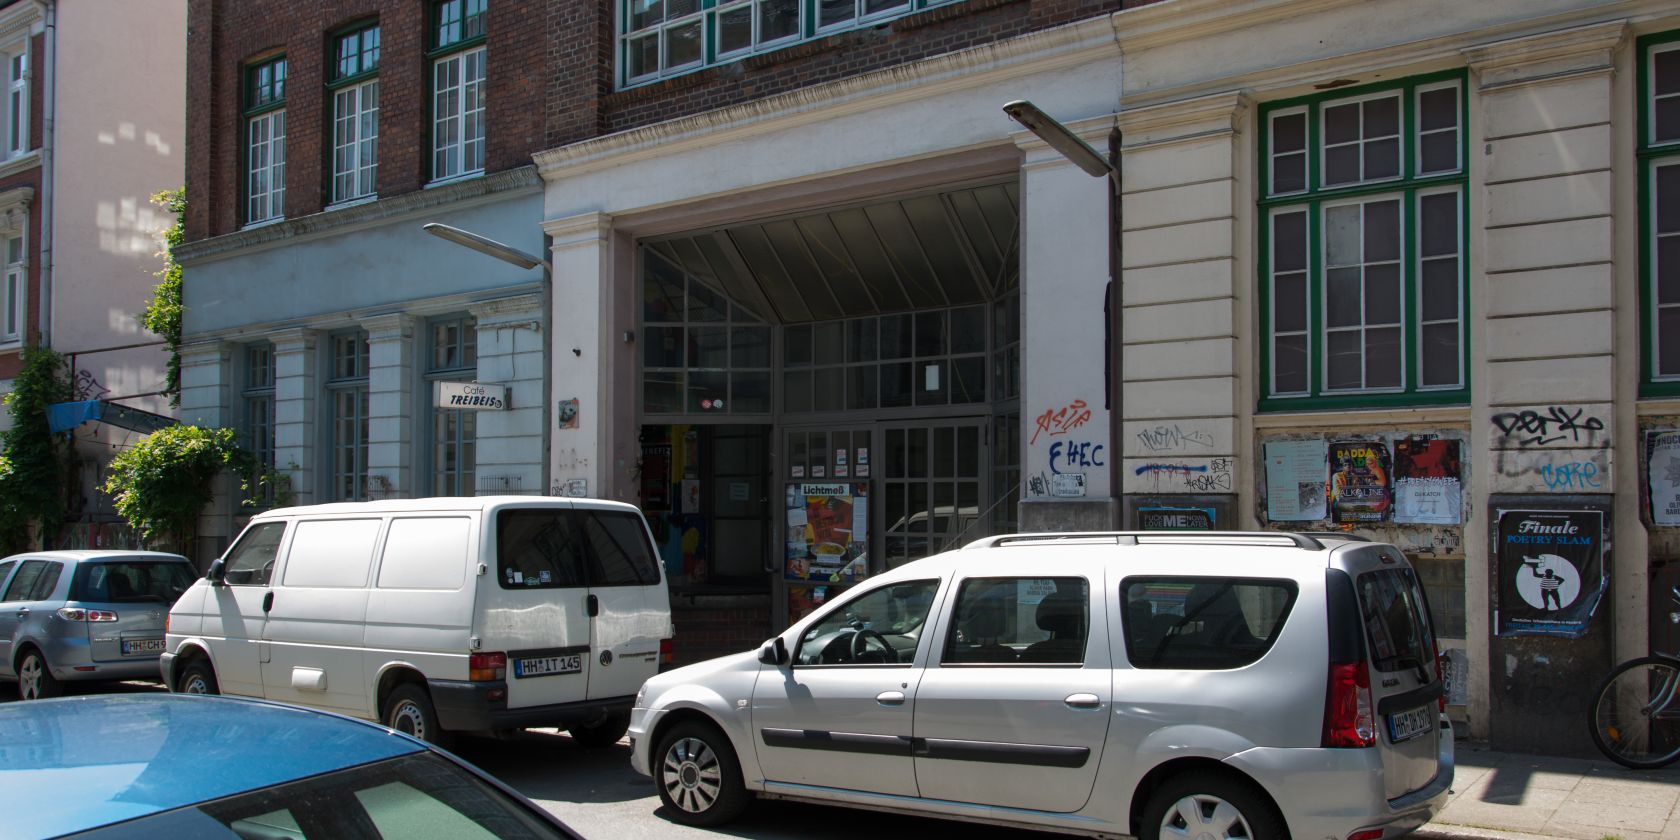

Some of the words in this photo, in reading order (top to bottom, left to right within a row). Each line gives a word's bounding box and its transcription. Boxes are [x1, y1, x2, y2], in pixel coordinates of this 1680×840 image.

[463, 385, 485, 395] Café
[450, 395, 496, 406] TREIBEIS
[803, 484, 844, 495] Lichtmeß
[1163, 515, 1186, 527] ME
[1518, 519, 1579, 535] Finale
[1507, 534, 1553, 545] POETRY
[1556, 535, 1592, 545] SLAM
[129, 642, 142, 651] HH
[147, 641, 160, 649] CH
[523, 660, 538, 673] HH
[545, 659, 558, 672] IT
[561, 657, 580, 670] 145
[1394, 715, 1406, 736] HH
